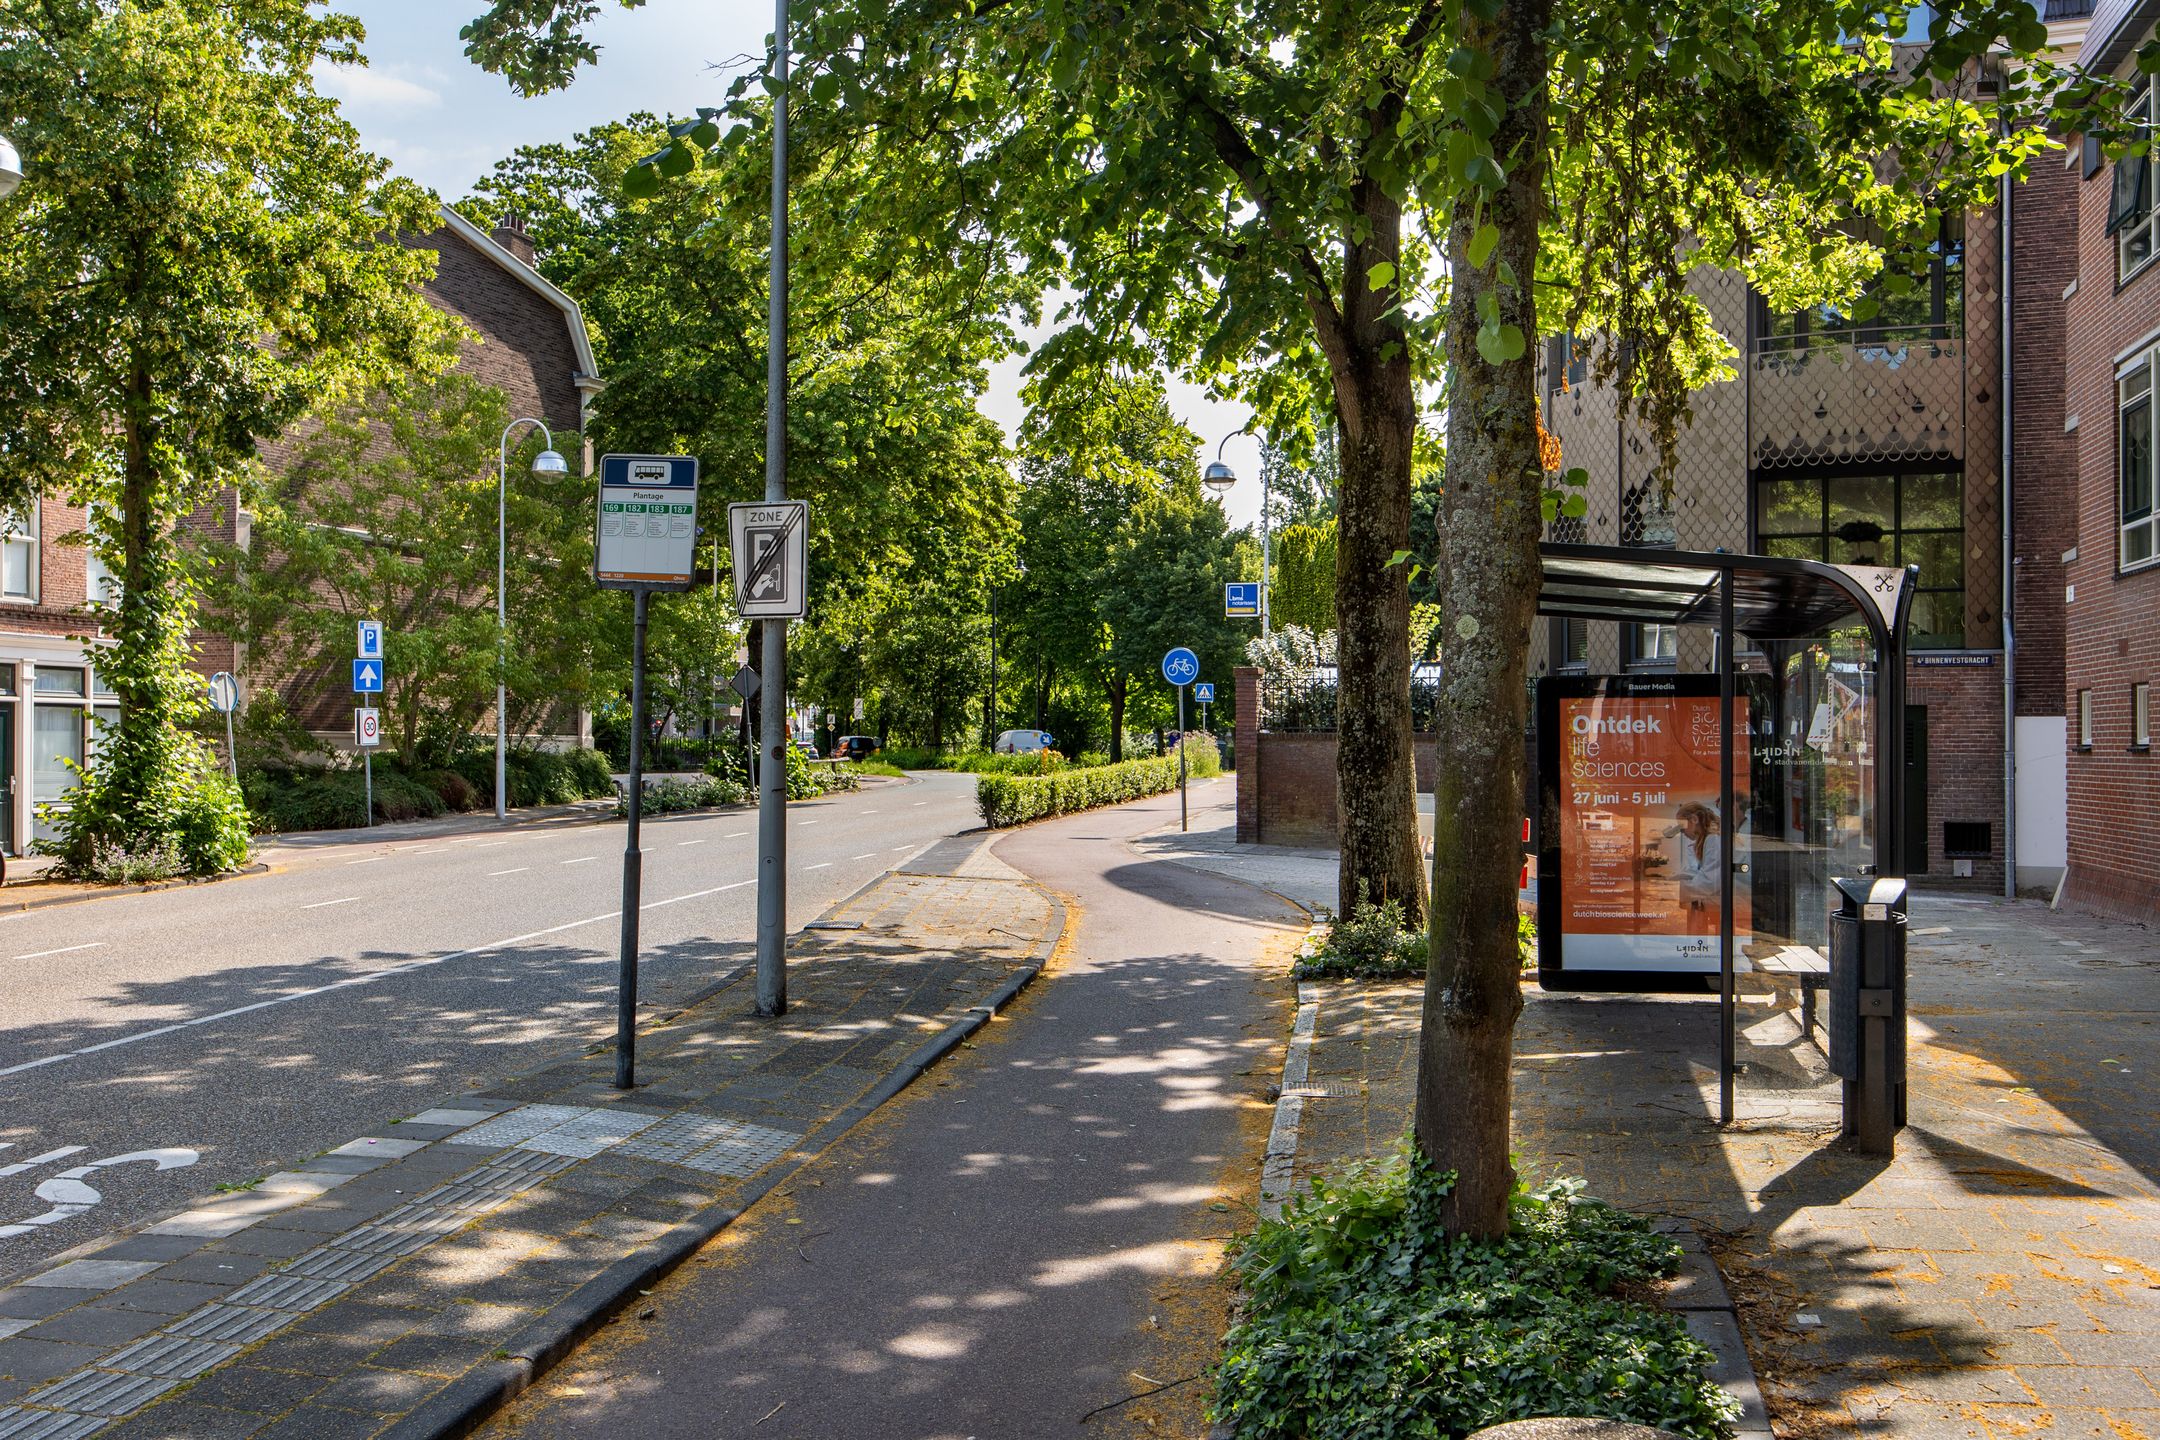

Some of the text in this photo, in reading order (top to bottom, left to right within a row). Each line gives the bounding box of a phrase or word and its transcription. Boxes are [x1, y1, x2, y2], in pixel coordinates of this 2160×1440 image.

[633, 492, 664, 501] Plantage
[650, 505, 665, 513] 183
[750, 511, 783, 522] ZONE
[366, 631, 374, 644] P
[1924, 656, 1989, 665] BINNENVESTGRACHT
[1692, 712, 1715, 723] BIO
[366, 722, 374, 731] 30
[1572, 715, 1662, 734] Ontdek
[1573, 736, 1600, 756] life
[1692, 736, 1721, 746] WEE
[1572, 758, 1665, 777] sciences
[1572, 792, 1591, 804] 27
[1593, 792, 1619, 807] juni
[1632, 792, 1641, 804] 5
[1644, 791, 1665, 806] juli
[1573, 910, 1667, 918] dutchbioscienceweek.nl
